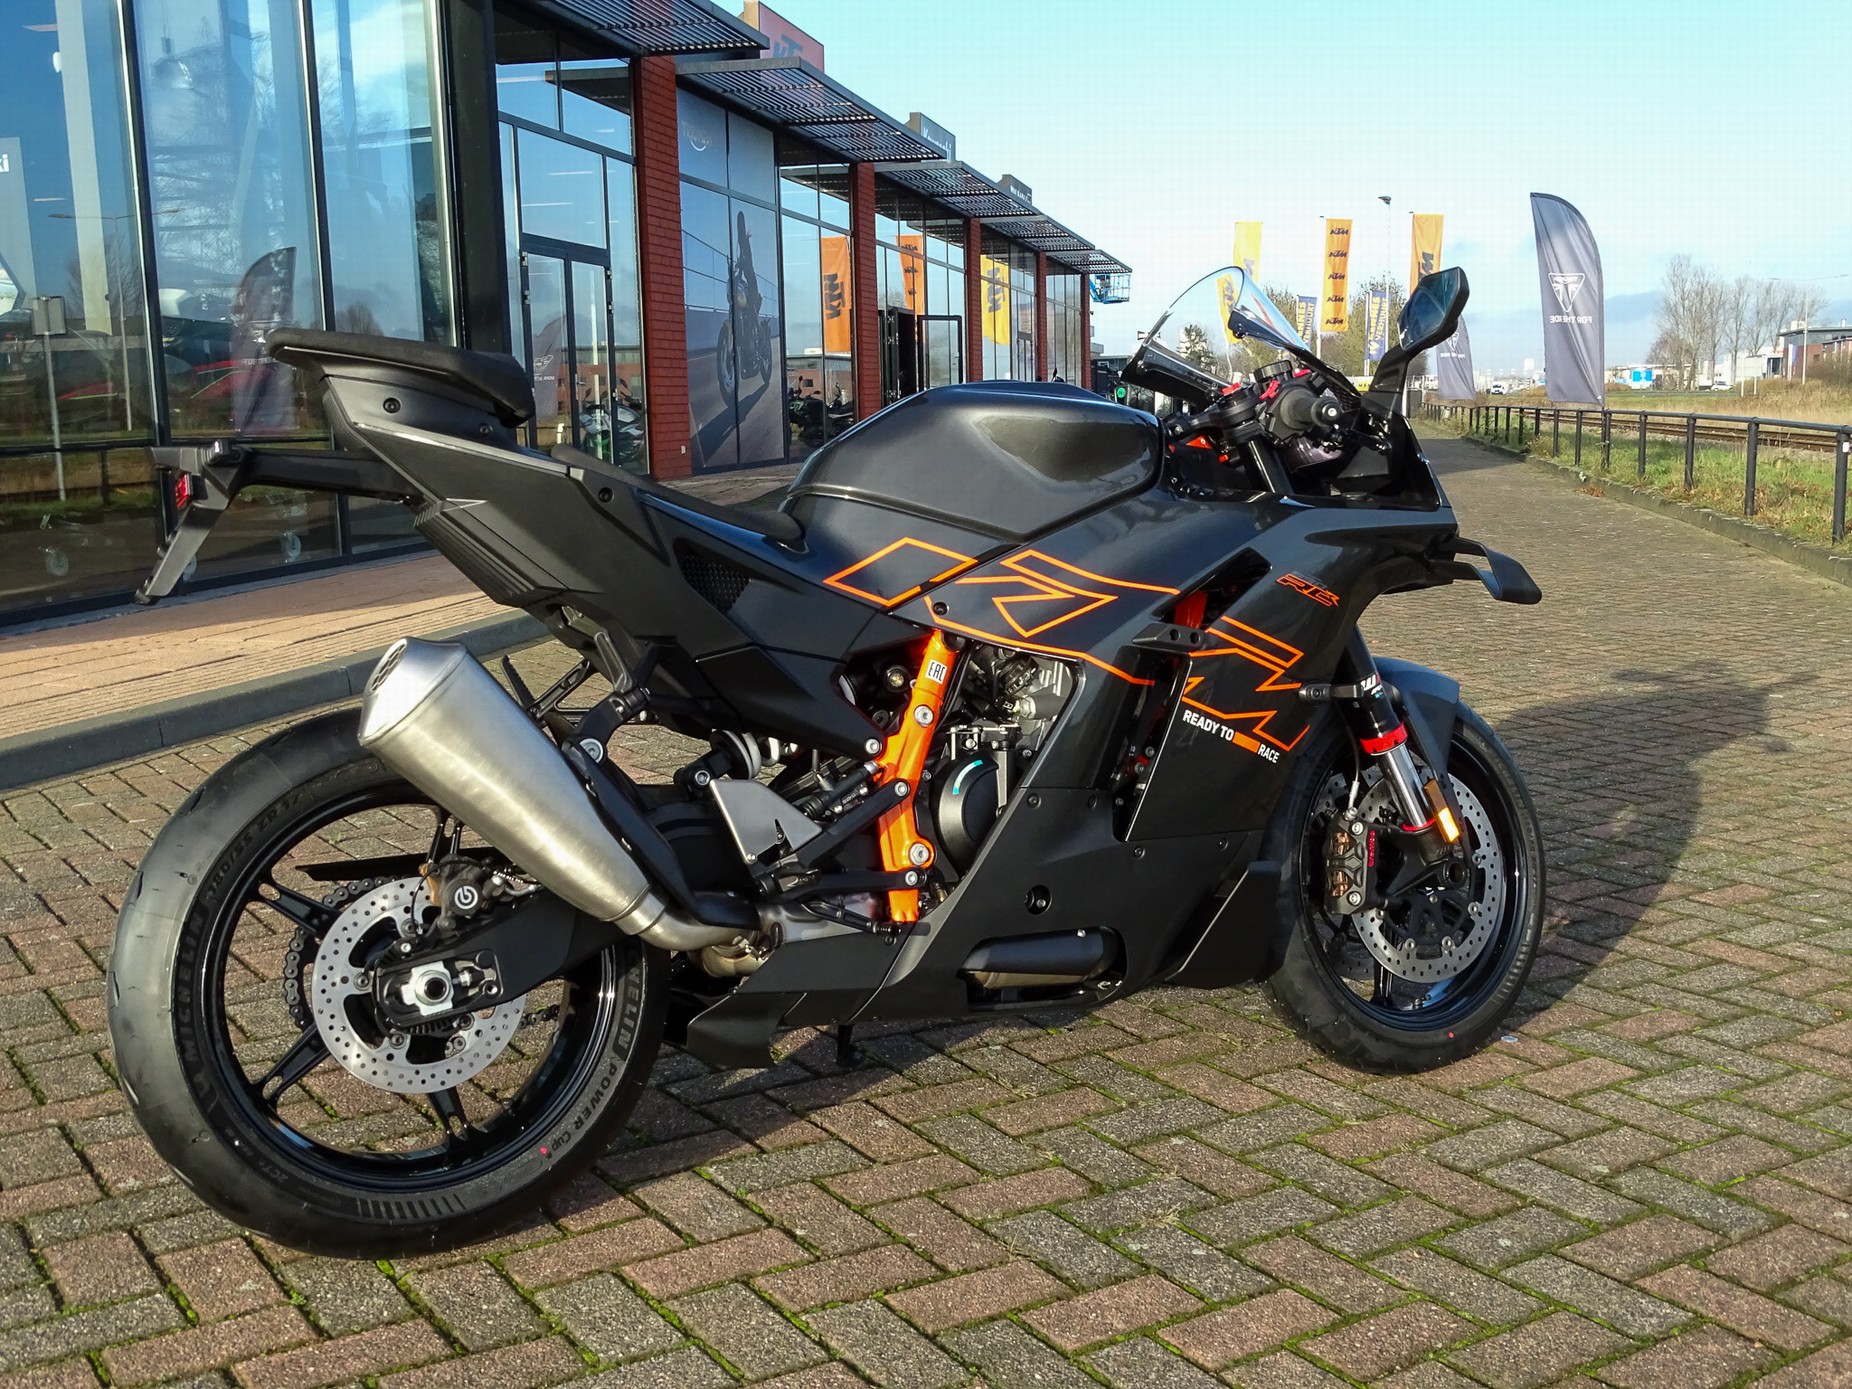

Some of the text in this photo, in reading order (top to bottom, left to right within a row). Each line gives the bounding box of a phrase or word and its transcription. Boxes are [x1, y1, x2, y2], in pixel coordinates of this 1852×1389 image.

[1330, 227, 1349, 235] KTM
[1329, 250, 1347, 258] KTM
[1328, 272, 1345, 280] KTM
[1327, 294, 1344, 302] KTM
[1325, 316, 1344, 325] KTM
[928, 661, 945, 682] EAC
[1182, 709, 1235, 742] READY TO
[1258, 743, 1280, 764] RACE
[256, 806, 280, 834] ZR
[177, 911, 205, 1065] MICHELIN
[575, 1060, 618, 1131] POWER
